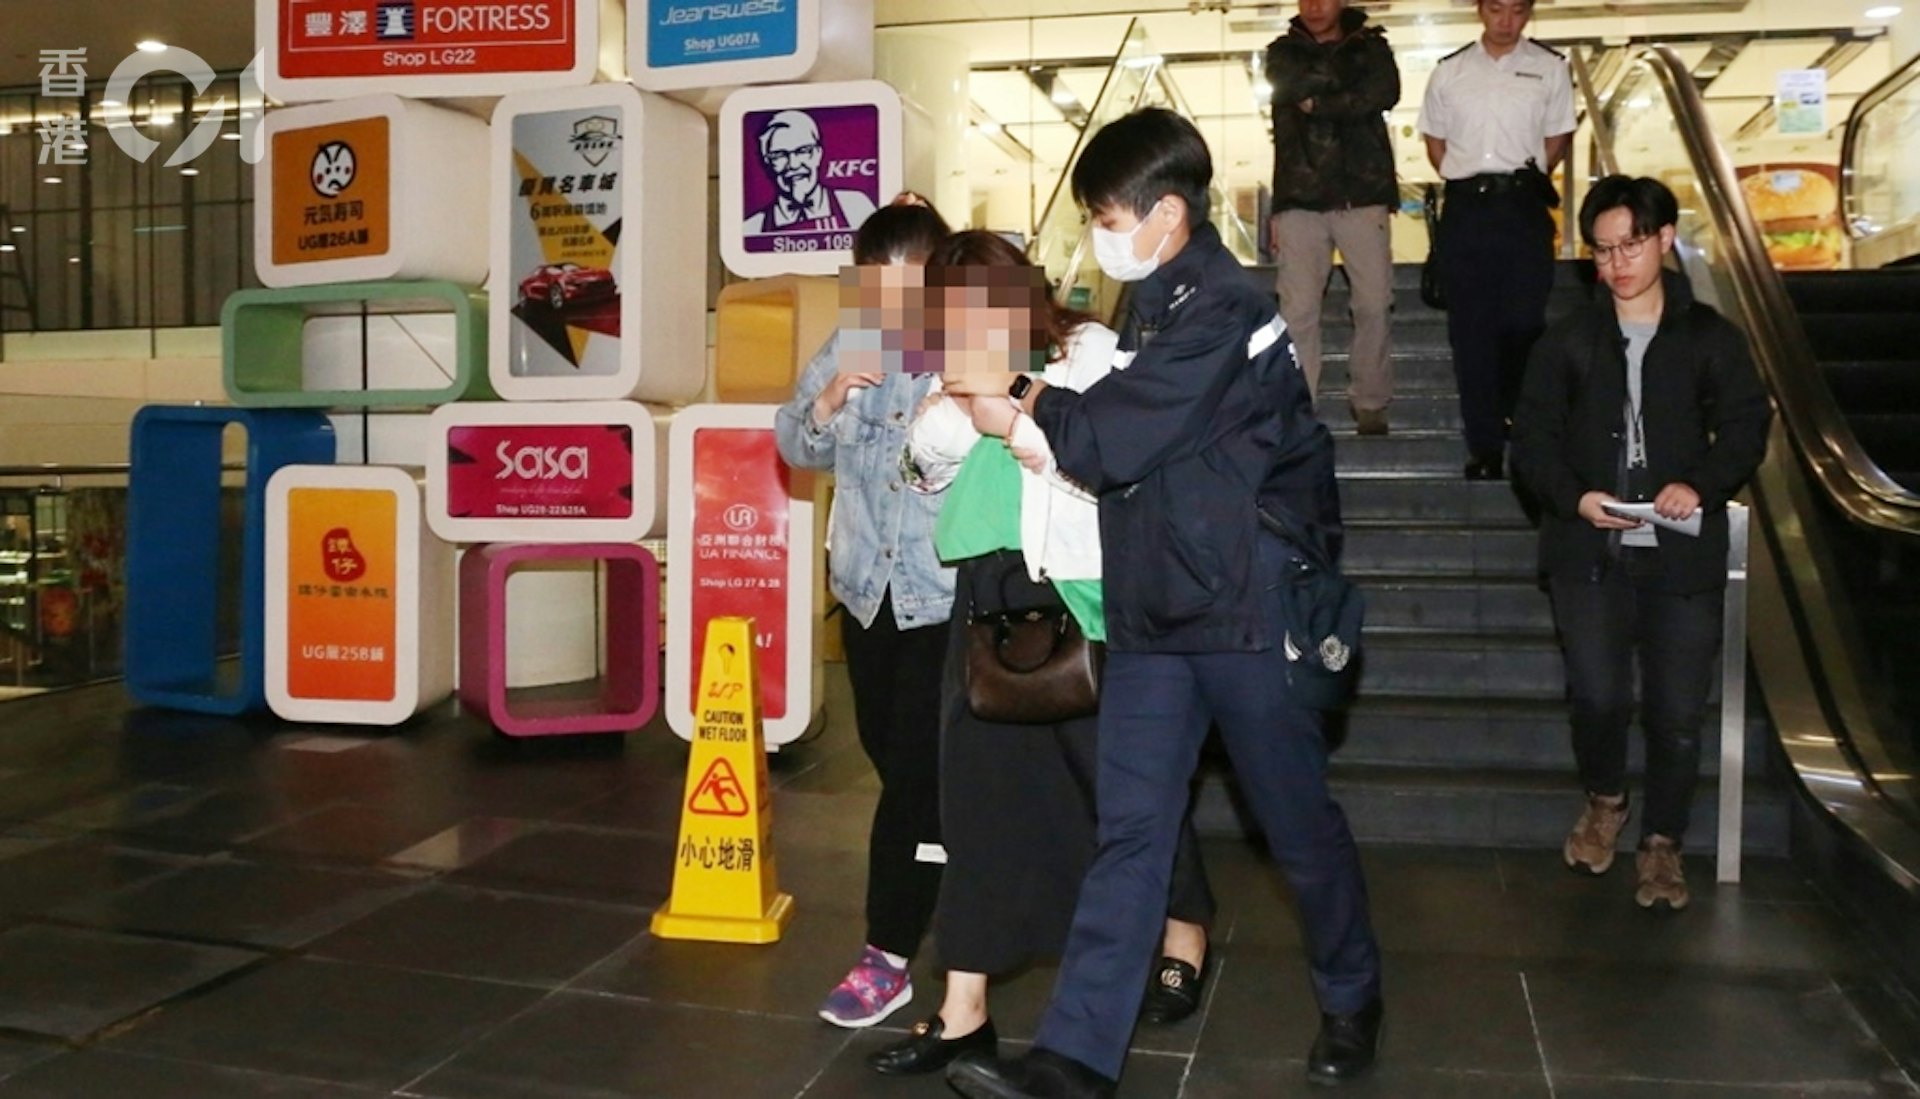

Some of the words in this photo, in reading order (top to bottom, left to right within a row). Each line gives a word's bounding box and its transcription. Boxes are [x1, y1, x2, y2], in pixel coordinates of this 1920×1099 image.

[305, 10, 368, 37] 豐澤
[422, 3, 551, 33] FORTRESS
[659, 0, 786, 26] Jeanswest
[684, 37, 715, 51] Shop
[718, 33, 760, 47] UG07A
[383, 51, 424, 66] Shop
[430, 49, 476, 65] LG22
[826, 159, 877, 178] KFC
[773, 237, 818, 251] Shop
[824, 234, 853, 250] 109
[495, 440, 589, 480] Sasa
[699, 549, 719, 560] UA
[723, 548, 781, 561] FINANCE
[700, 577, 726, 589] Shop
[728, 577, 742, 588] LG
[704, 709, 744, 725] CAUTION
[699, 726, 717, 740] WET
[719, 726, 747, 742] FLOOR
[681, 835, 755, 872] 小心地滑
